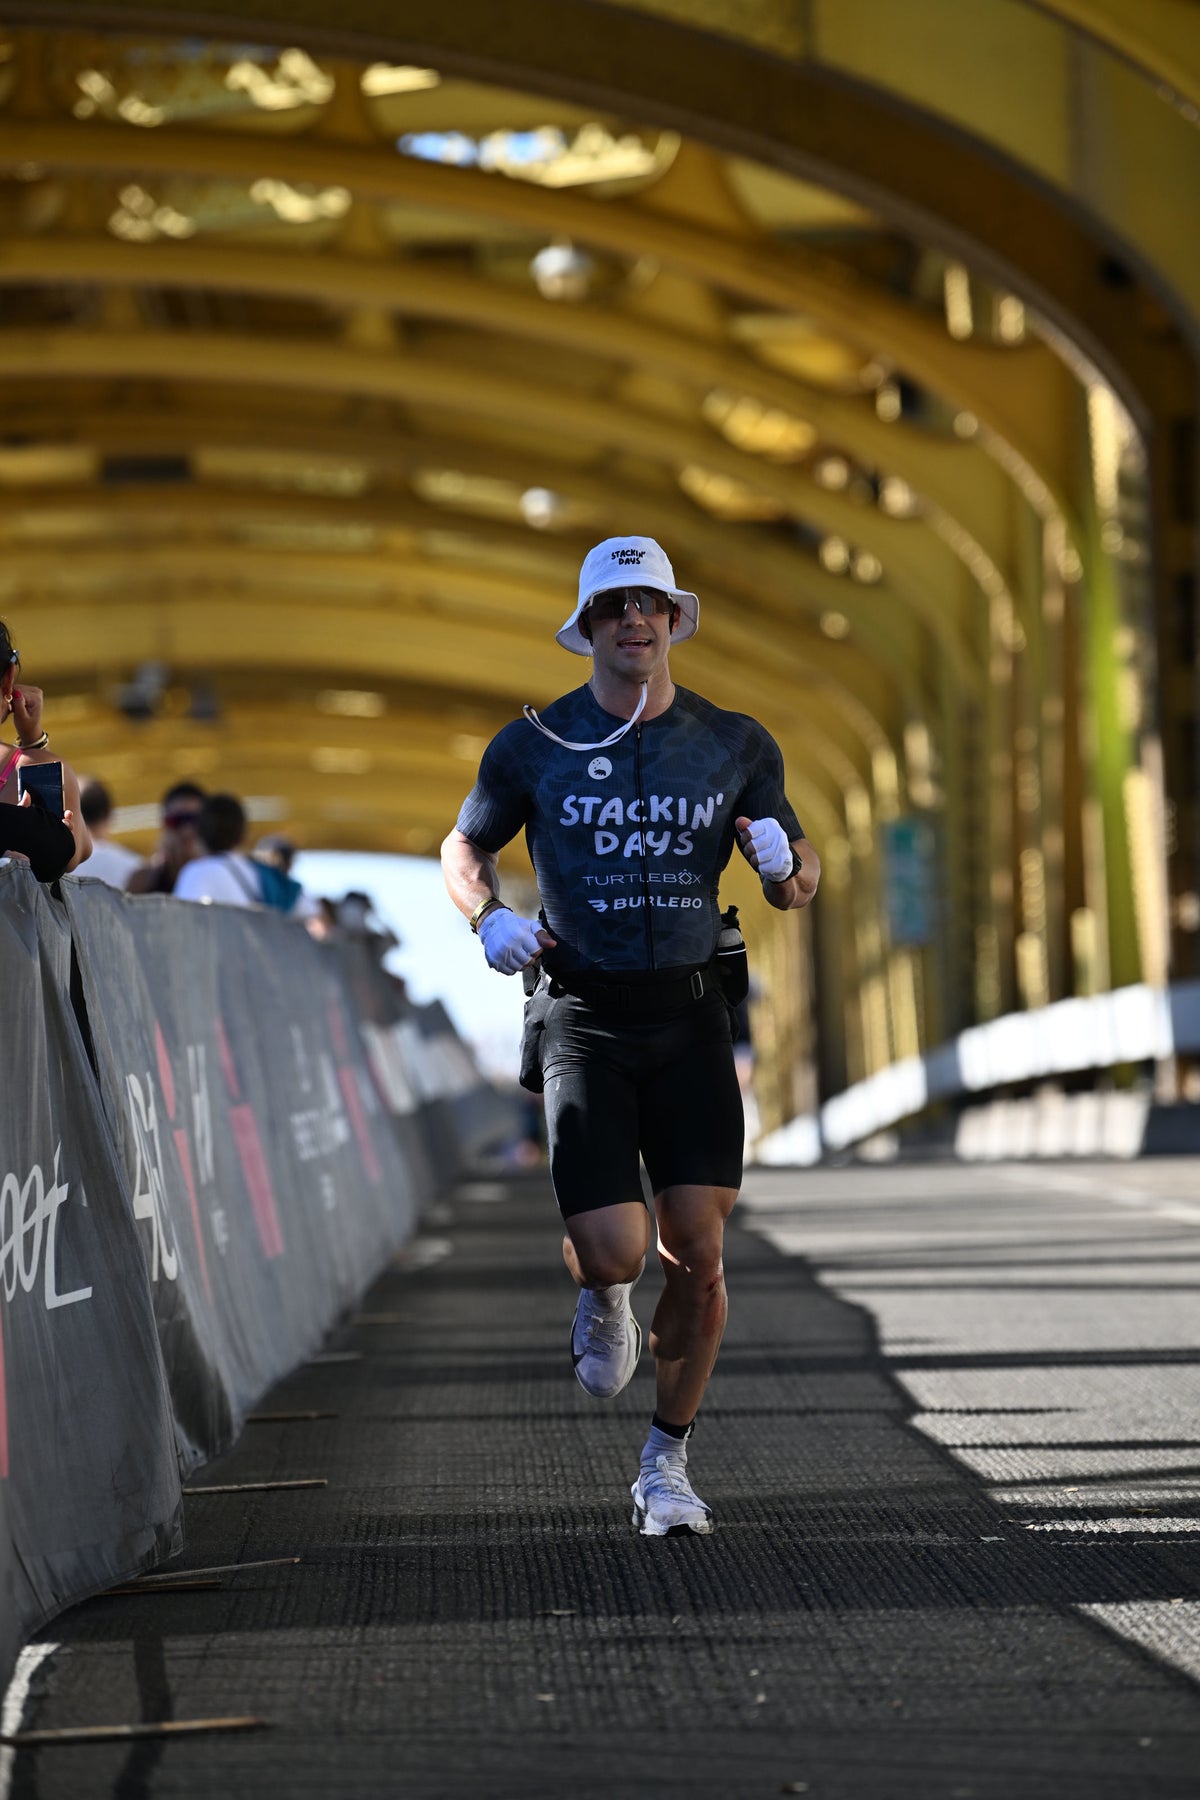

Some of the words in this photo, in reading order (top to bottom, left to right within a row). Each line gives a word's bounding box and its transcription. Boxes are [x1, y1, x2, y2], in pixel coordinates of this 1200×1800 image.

[611, 549, 646, 560] STACKIN'
[618, 557, 641, 565] DAYS
[559, 792, 724, 830] STACKIN'
[594, 830, 694, 858] DAYS
[582, 869, 702, 887] TURTLEBOX
[613, 895, 703, 910] BURLEBO
